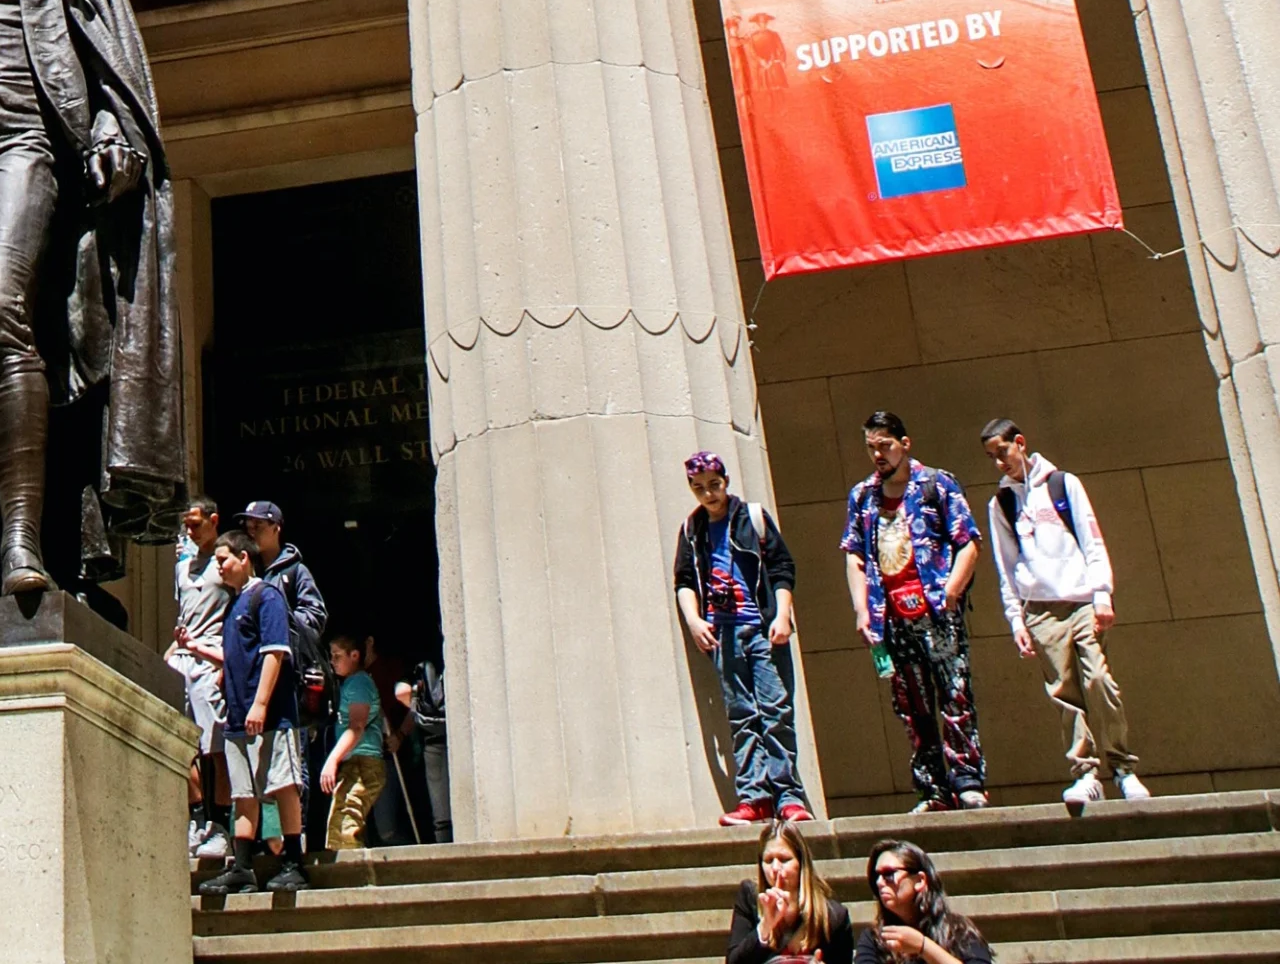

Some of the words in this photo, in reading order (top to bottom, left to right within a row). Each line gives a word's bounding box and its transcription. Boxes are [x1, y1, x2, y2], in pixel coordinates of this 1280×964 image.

[796, 18, 959, 72] SUPPORTED
[965, 10, 1002, 40] BY
[874, 134, 953, 156] AMERICAN
[894, 149, 962, 170] EXPRESS
[283, 376, 405, 406] FEDERAL
[240, 407, 378, 438] NATIONAL
[317, 444, 390, 470] WALL
